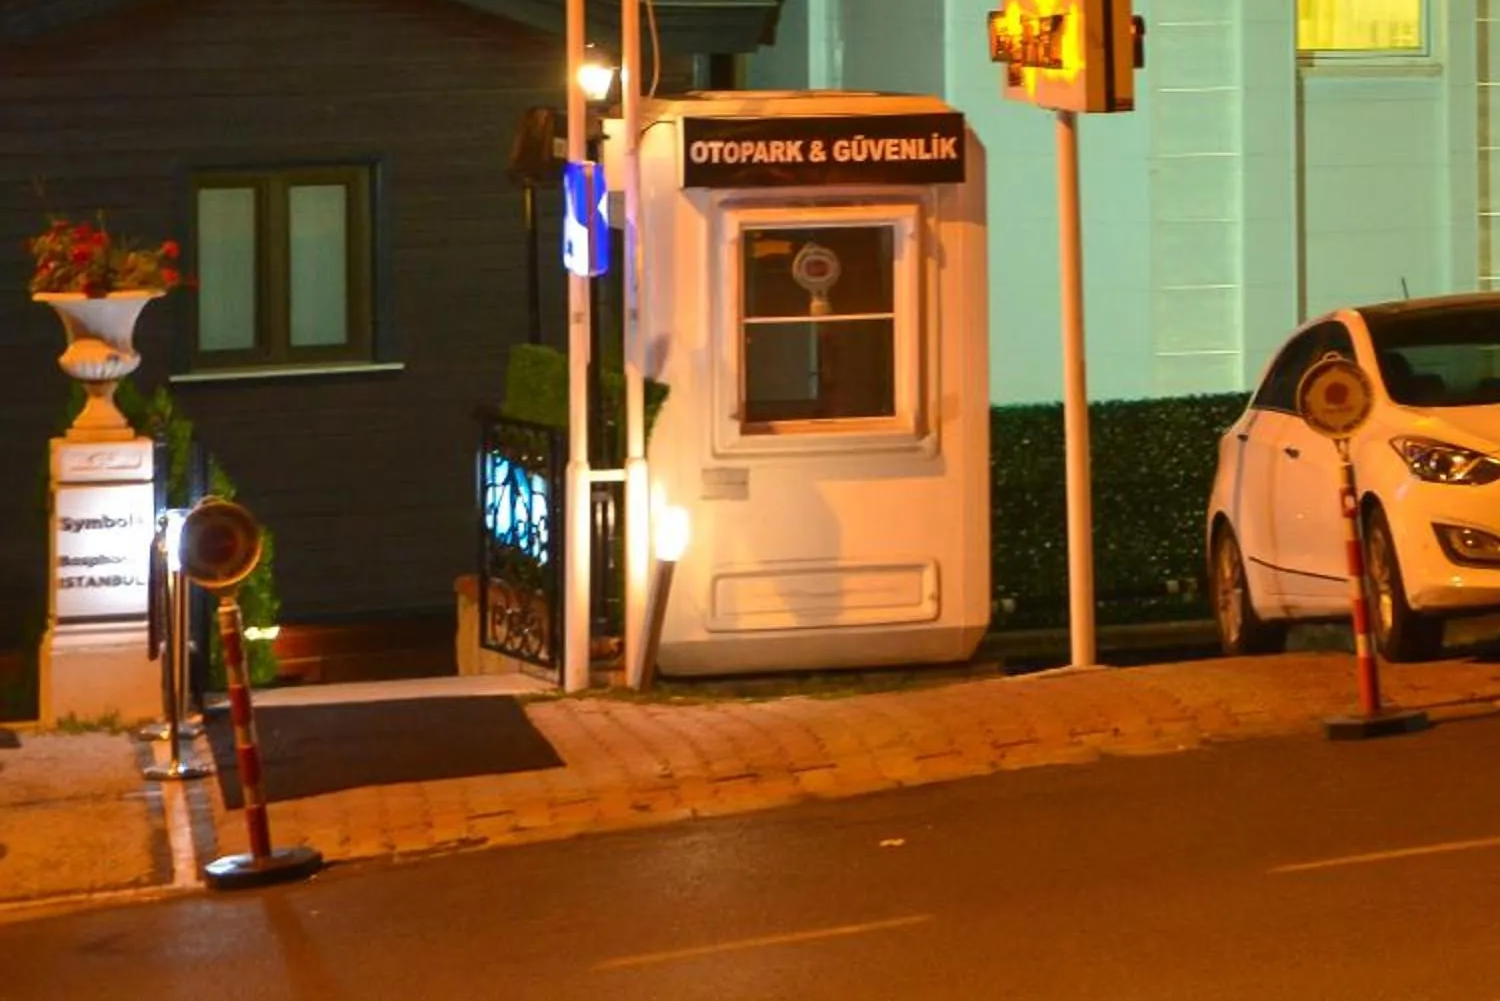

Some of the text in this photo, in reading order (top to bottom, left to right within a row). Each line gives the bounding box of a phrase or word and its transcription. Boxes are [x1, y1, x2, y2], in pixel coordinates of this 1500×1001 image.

[690, 132, 958, 164] OTOPARK & GÜVENLİK
